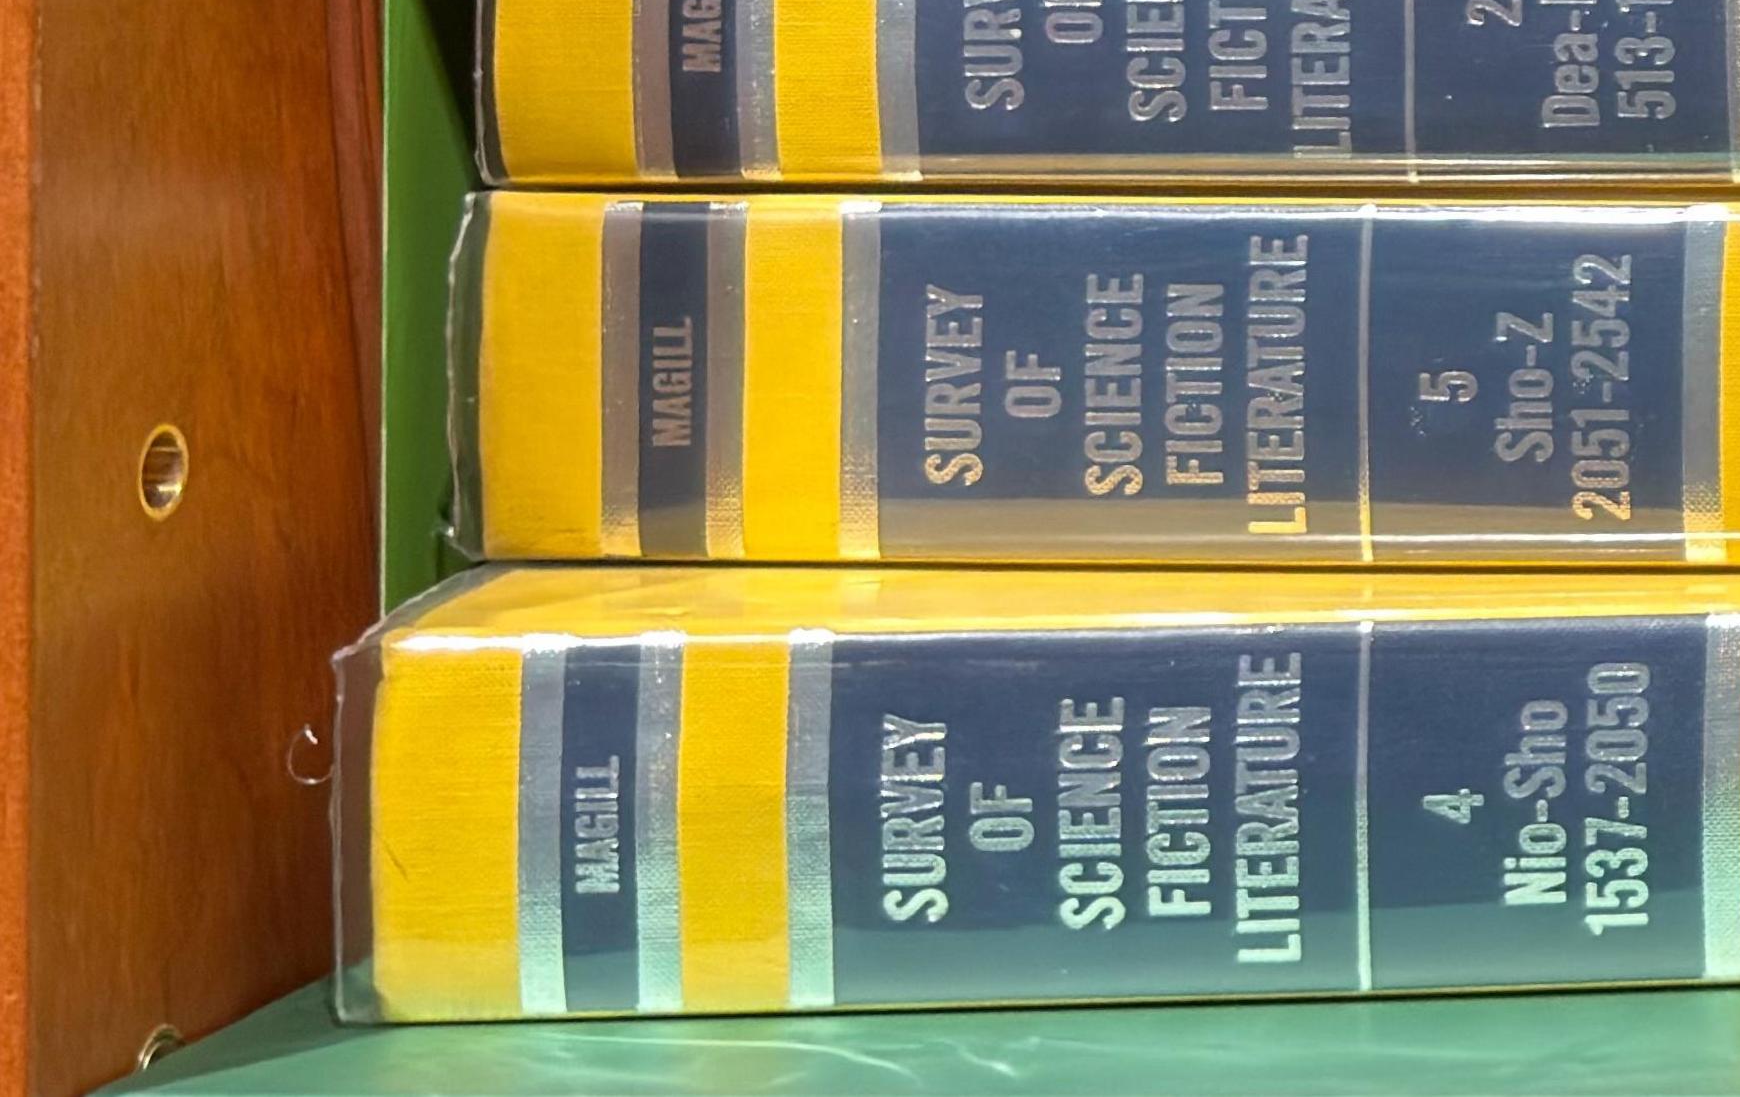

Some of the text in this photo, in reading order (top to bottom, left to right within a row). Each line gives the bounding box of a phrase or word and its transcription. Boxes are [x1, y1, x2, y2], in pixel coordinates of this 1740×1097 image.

[653, 315, 692, 447] MAGILL
[925, 285, 983, 488] SURVEY
[1006, 351, 1063, 419] OF
[1085, 273, 1145, 497] SCIENCE
[1166, 284, 1225, 487] FICTION
[1248, 234, 1309, 536] LITERATURE
[1420, 370, 1477, 402] 5
[1495, 312, 1554, 463] Sho-Z
[1572, 253, 1632, 521] 2051-2542
[576, 755, 620, 894] MAGILL
[882, 713, 949, 924] SURVEY
[969, 781, 1035, 851] OF
[1060, 696, 1126, 931] SCIENCE
[1147, 707, 1212, 918] FICTION
[1236, 652, 1302, 964] LITERATURE
[1423, 788, 1484, 826] 4
[1504, 699, 1568, 906] Nio-Sho
[1586, 662, 1651, 933] 1537-2050
